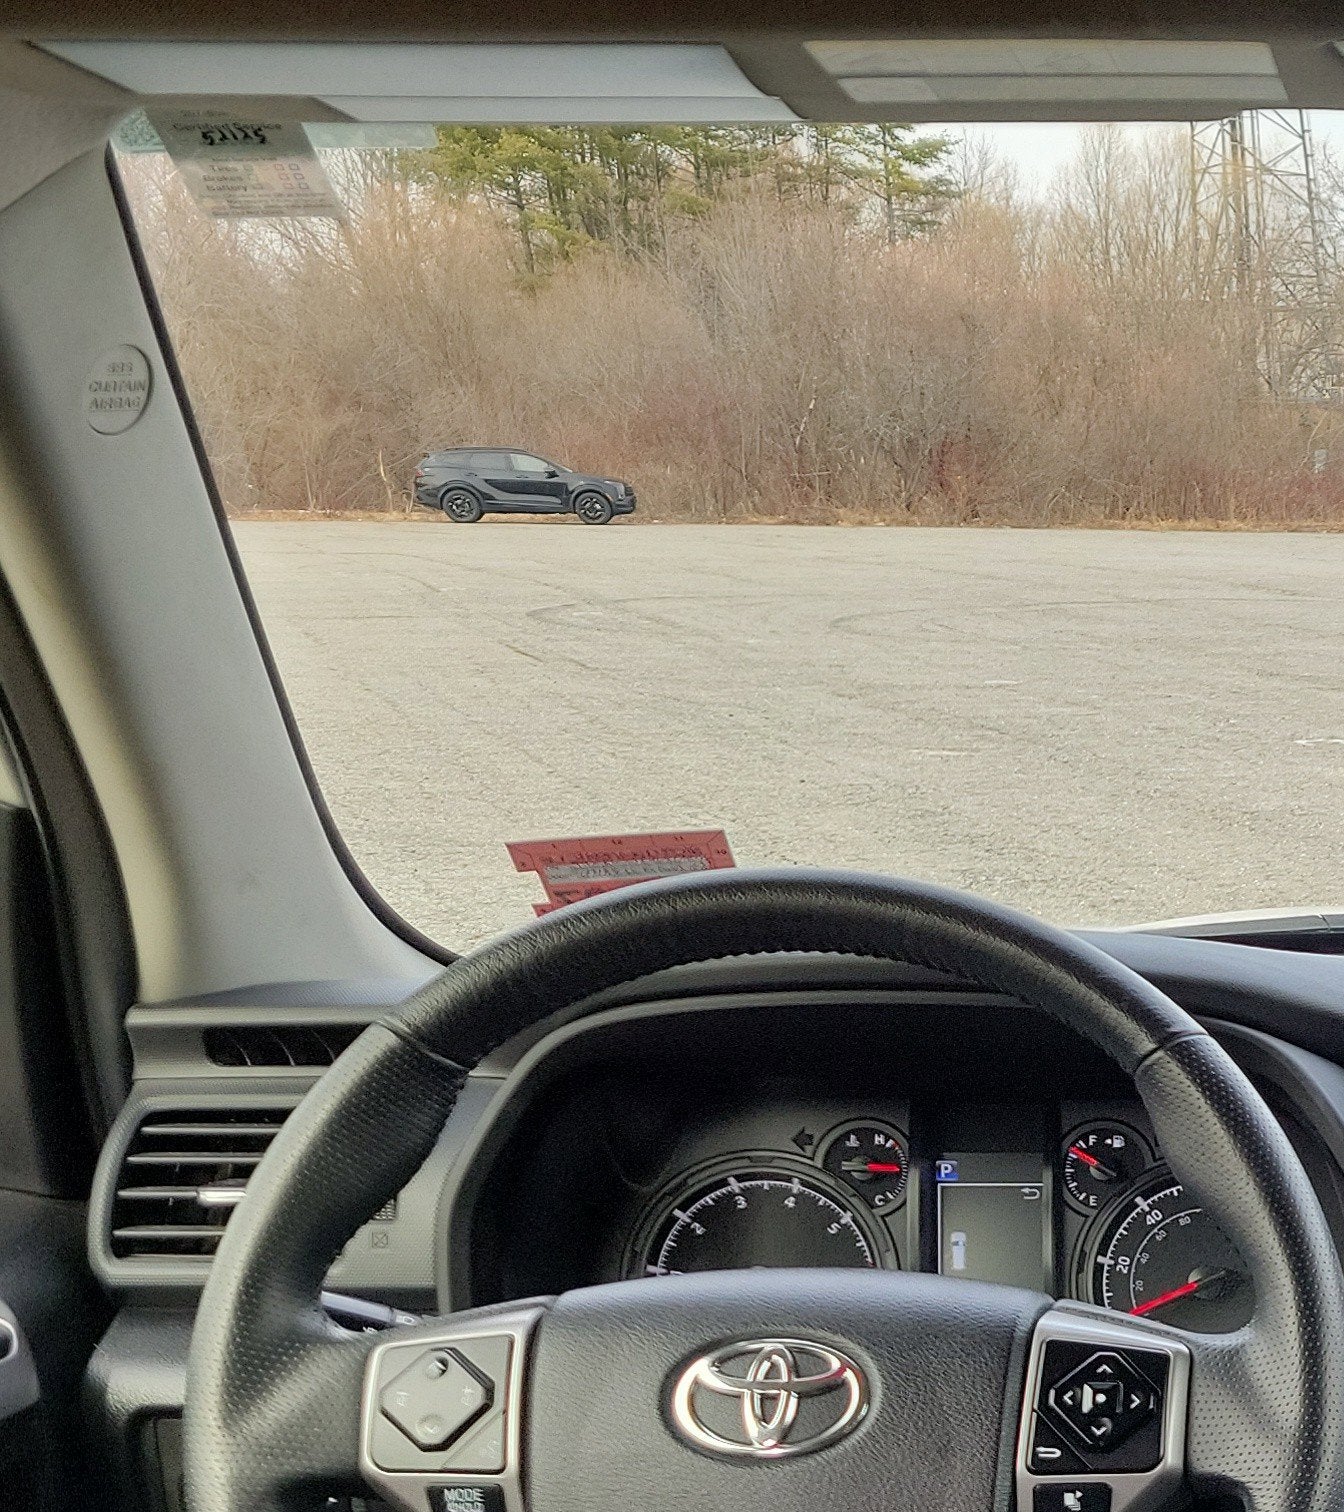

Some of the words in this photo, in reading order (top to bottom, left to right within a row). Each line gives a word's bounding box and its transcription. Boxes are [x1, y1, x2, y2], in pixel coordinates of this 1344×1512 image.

[1088, 1135, 1098, 1146] F
[940, 1163, 953, 1178] P
[733, 1195, 748, 1209] 3
[783, 1196, 797, 1209] 4
[1088, 1195, 1098, 1207] E
[1145, 1209, 1164, 1225] 40
[826, 1221, 842, 1235] 5
[1116, 1256, 1131, 1274] 20
[444, 1488, 485, 1502] MODE
